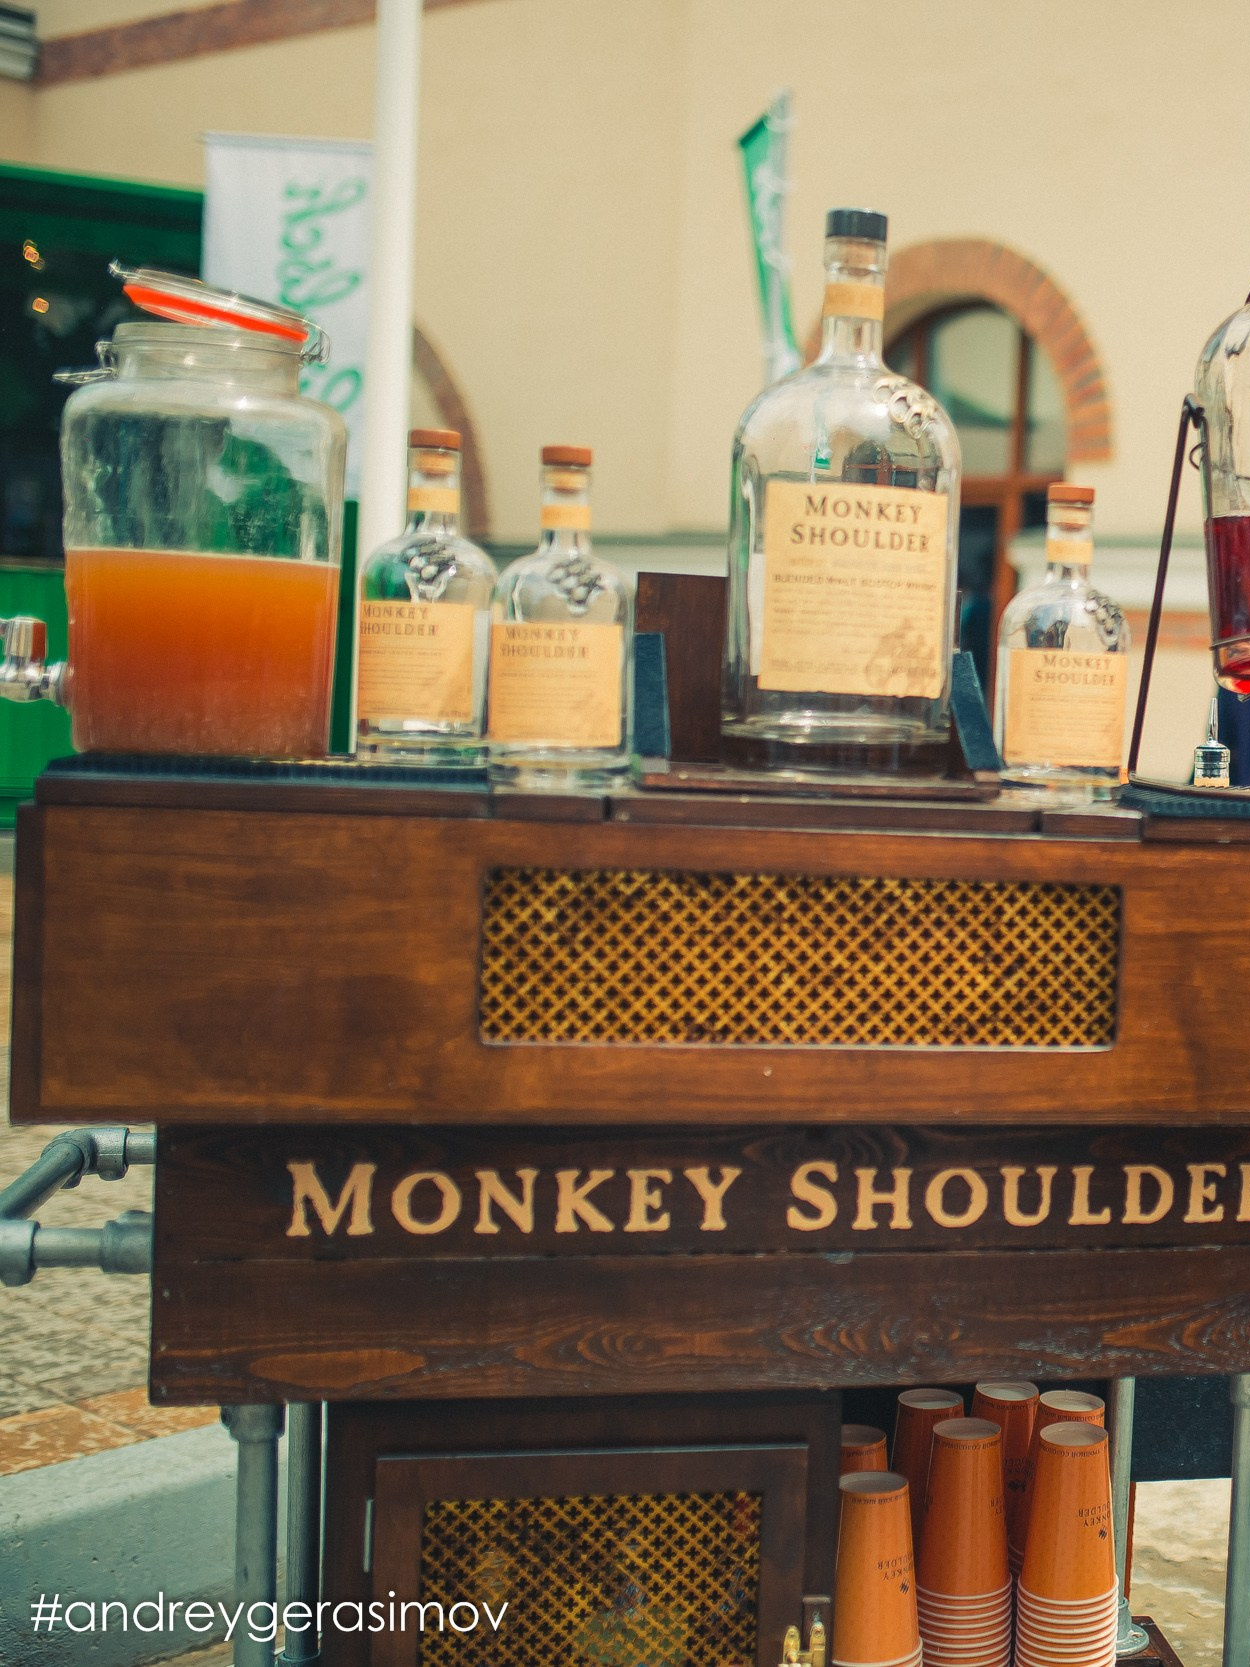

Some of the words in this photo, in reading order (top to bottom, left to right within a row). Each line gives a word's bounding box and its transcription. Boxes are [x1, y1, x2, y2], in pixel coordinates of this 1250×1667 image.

[805, 496, 922, 525] MONKEY
[790, 523, 930, 553] SHOULDER
[363, 604, 429, 619] MONKEY
[506, 626, 581, 641] MONKEY
[1043, 654, 1111, 670] MONKEY
[286, 1161, 742, 1237] MONKEY
